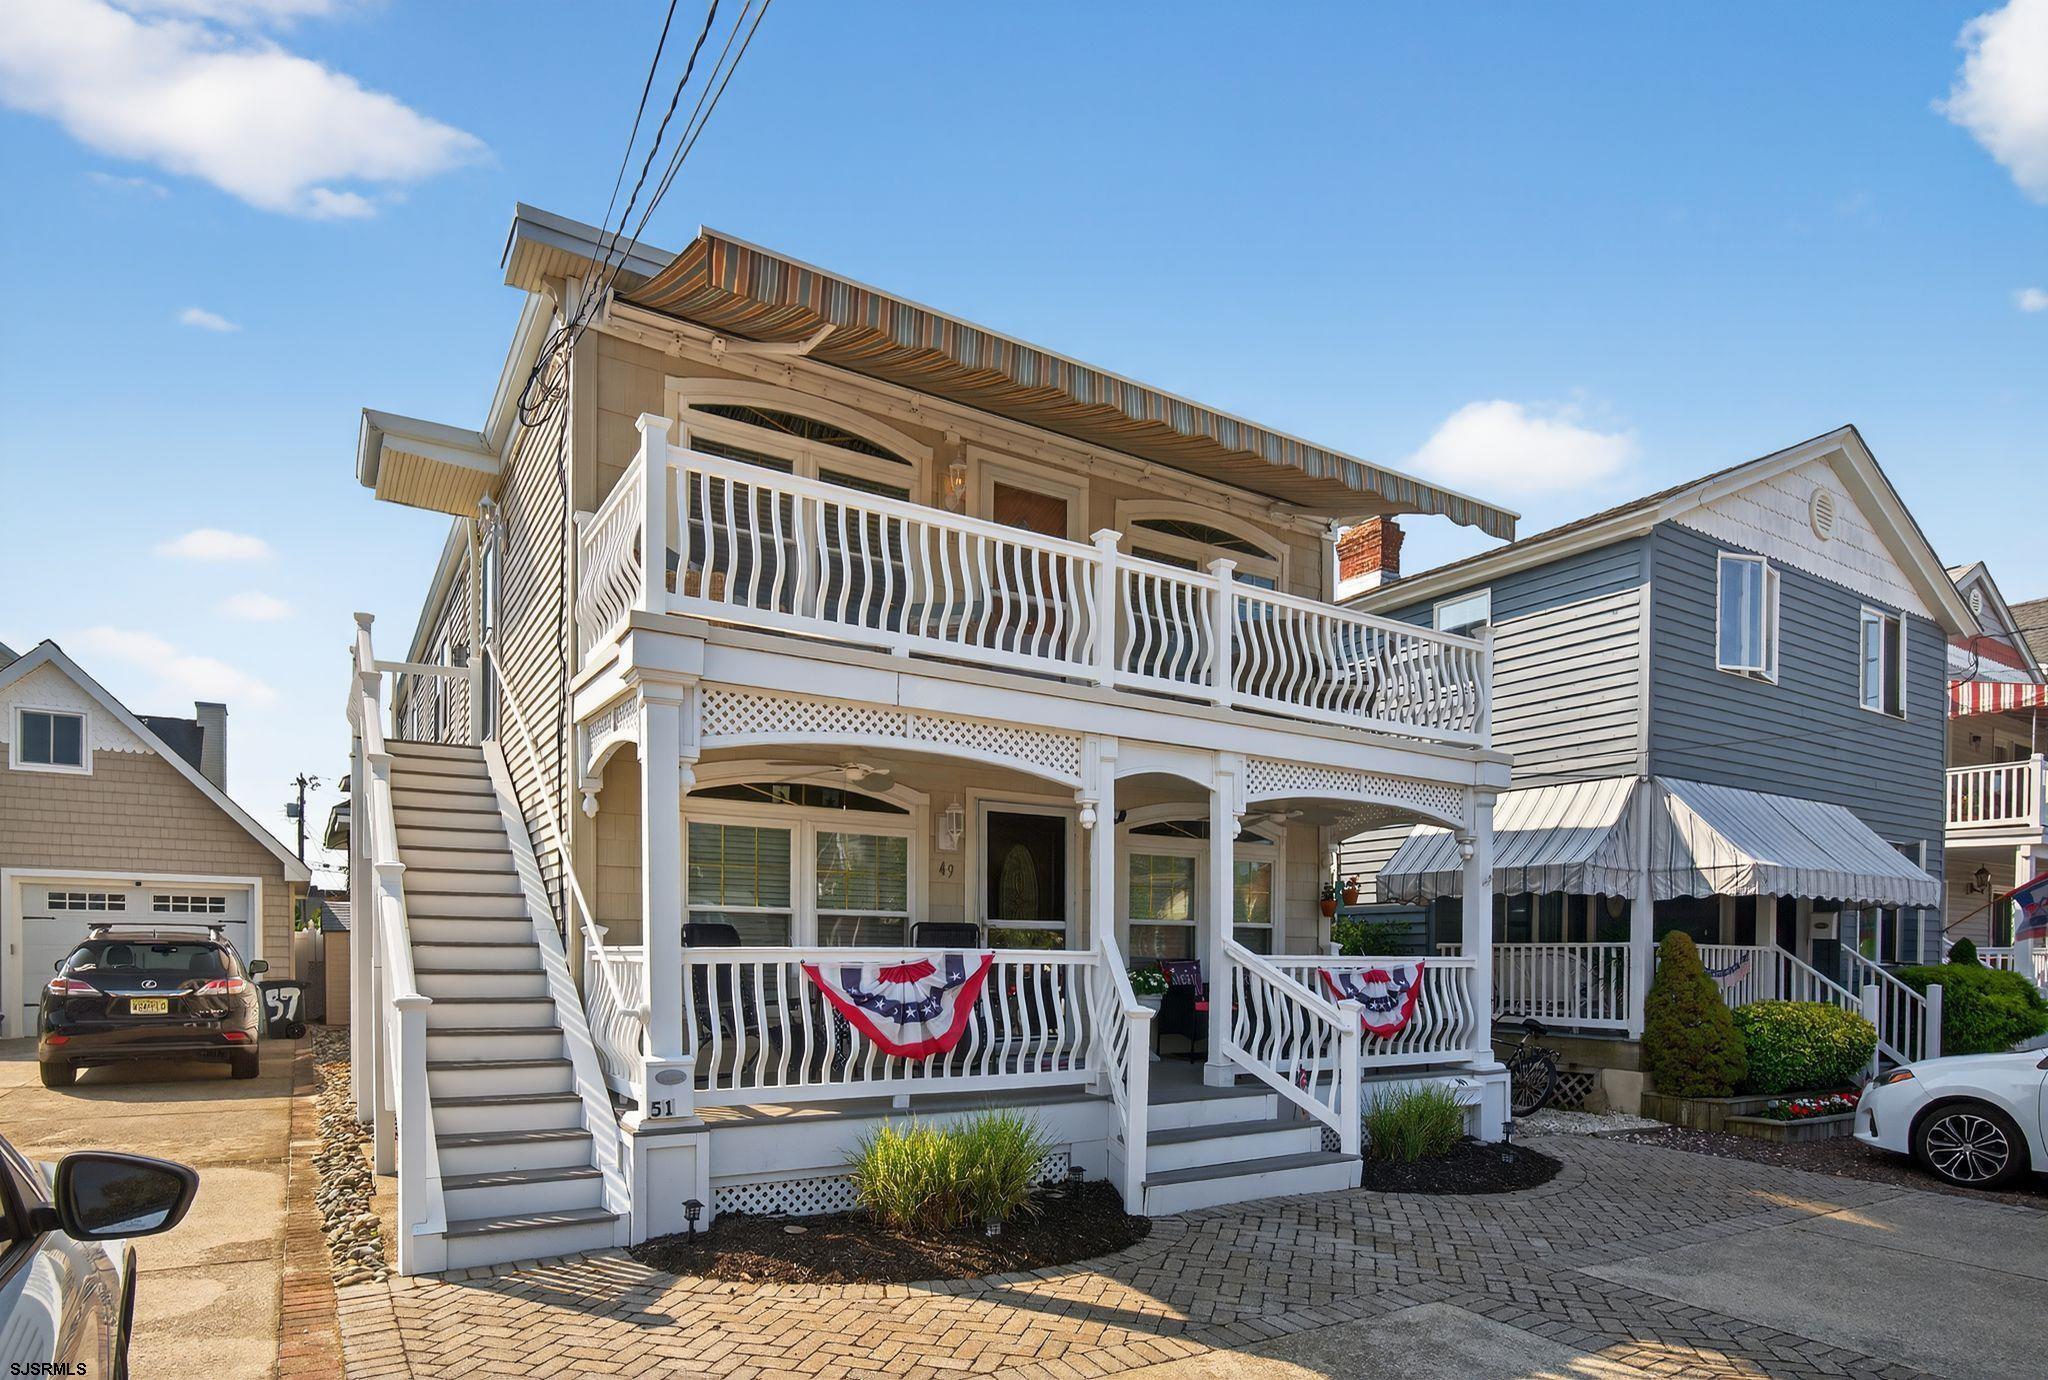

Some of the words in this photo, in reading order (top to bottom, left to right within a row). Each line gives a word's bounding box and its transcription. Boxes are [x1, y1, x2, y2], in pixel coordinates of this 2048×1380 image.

[938, 860, 954, 879] 49
[265, 987, 301, 1022] 57
[651, 1100, 673, 1117] 51
